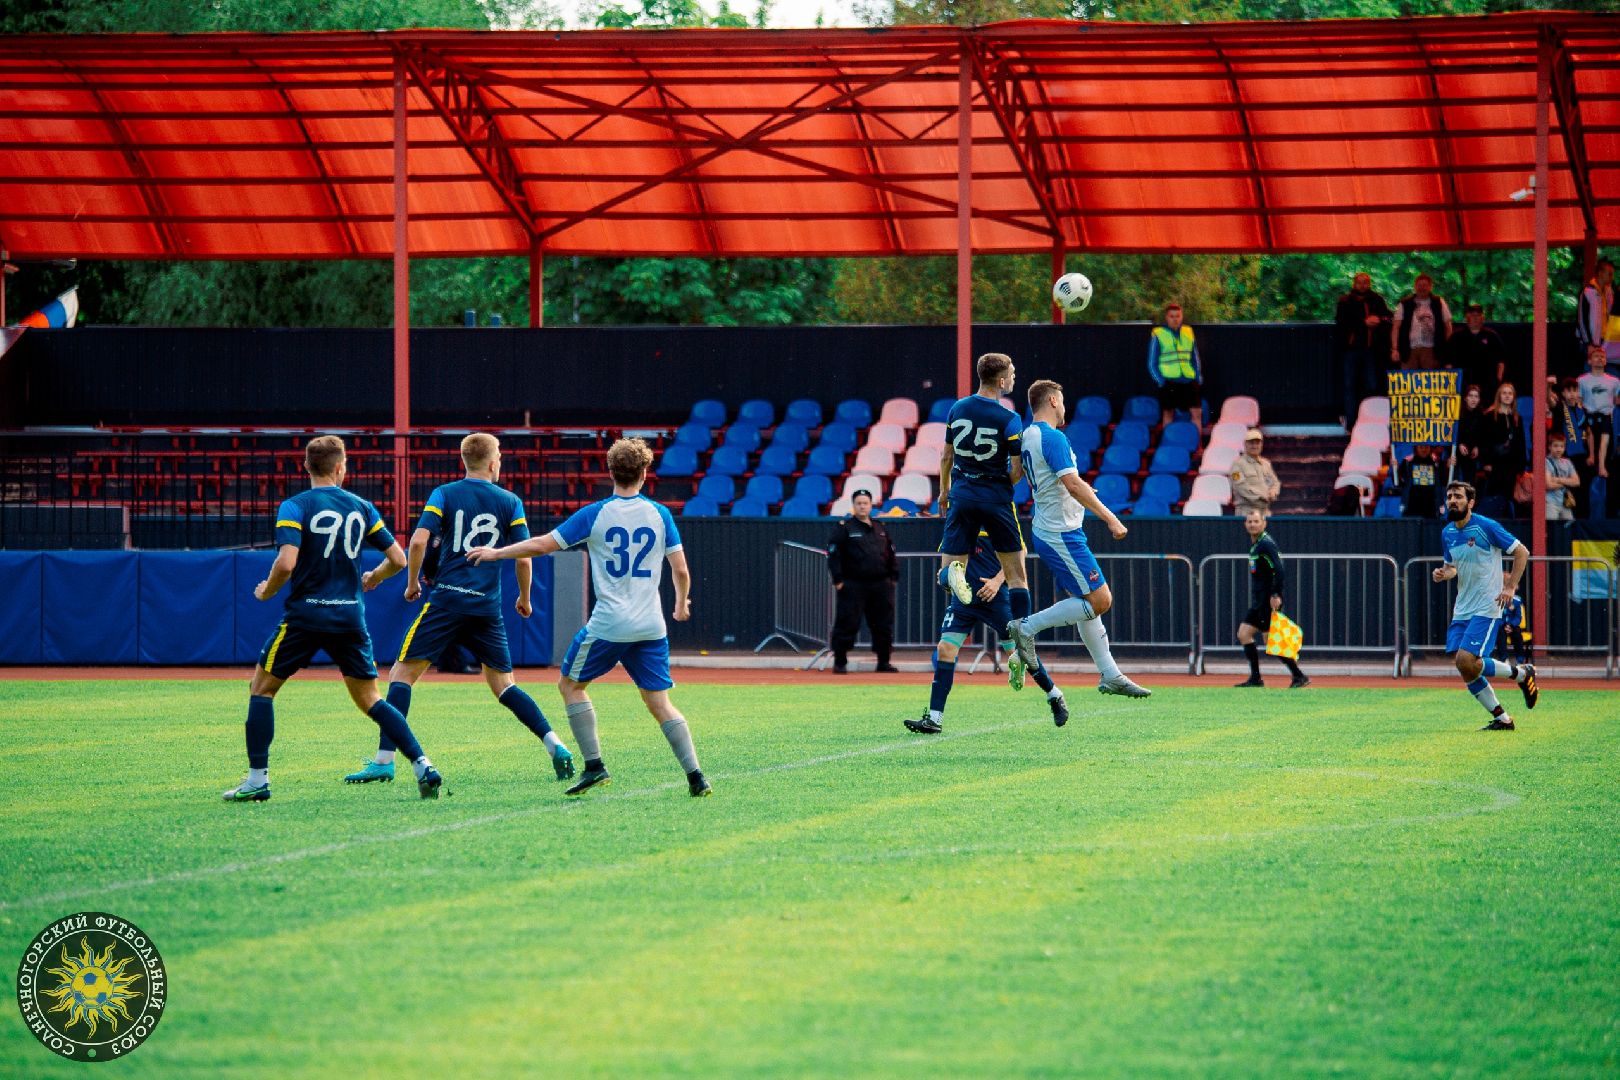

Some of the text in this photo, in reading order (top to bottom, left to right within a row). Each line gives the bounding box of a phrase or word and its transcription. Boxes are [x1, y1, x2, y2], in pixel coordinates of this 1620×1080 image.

[1387, 371, 1458, 395] МЫ СЕНЕЖ
[1390, 396, 1458, 419] И НАМ ЭТО
[951, 418, 998, 461] 25
[1390, 420, 1455, 443] НРАВИТСЯ
[310, 509, 366, 559] 90
[453, 509, 499, 554] 18
[605, 526, 656, 578] 32
